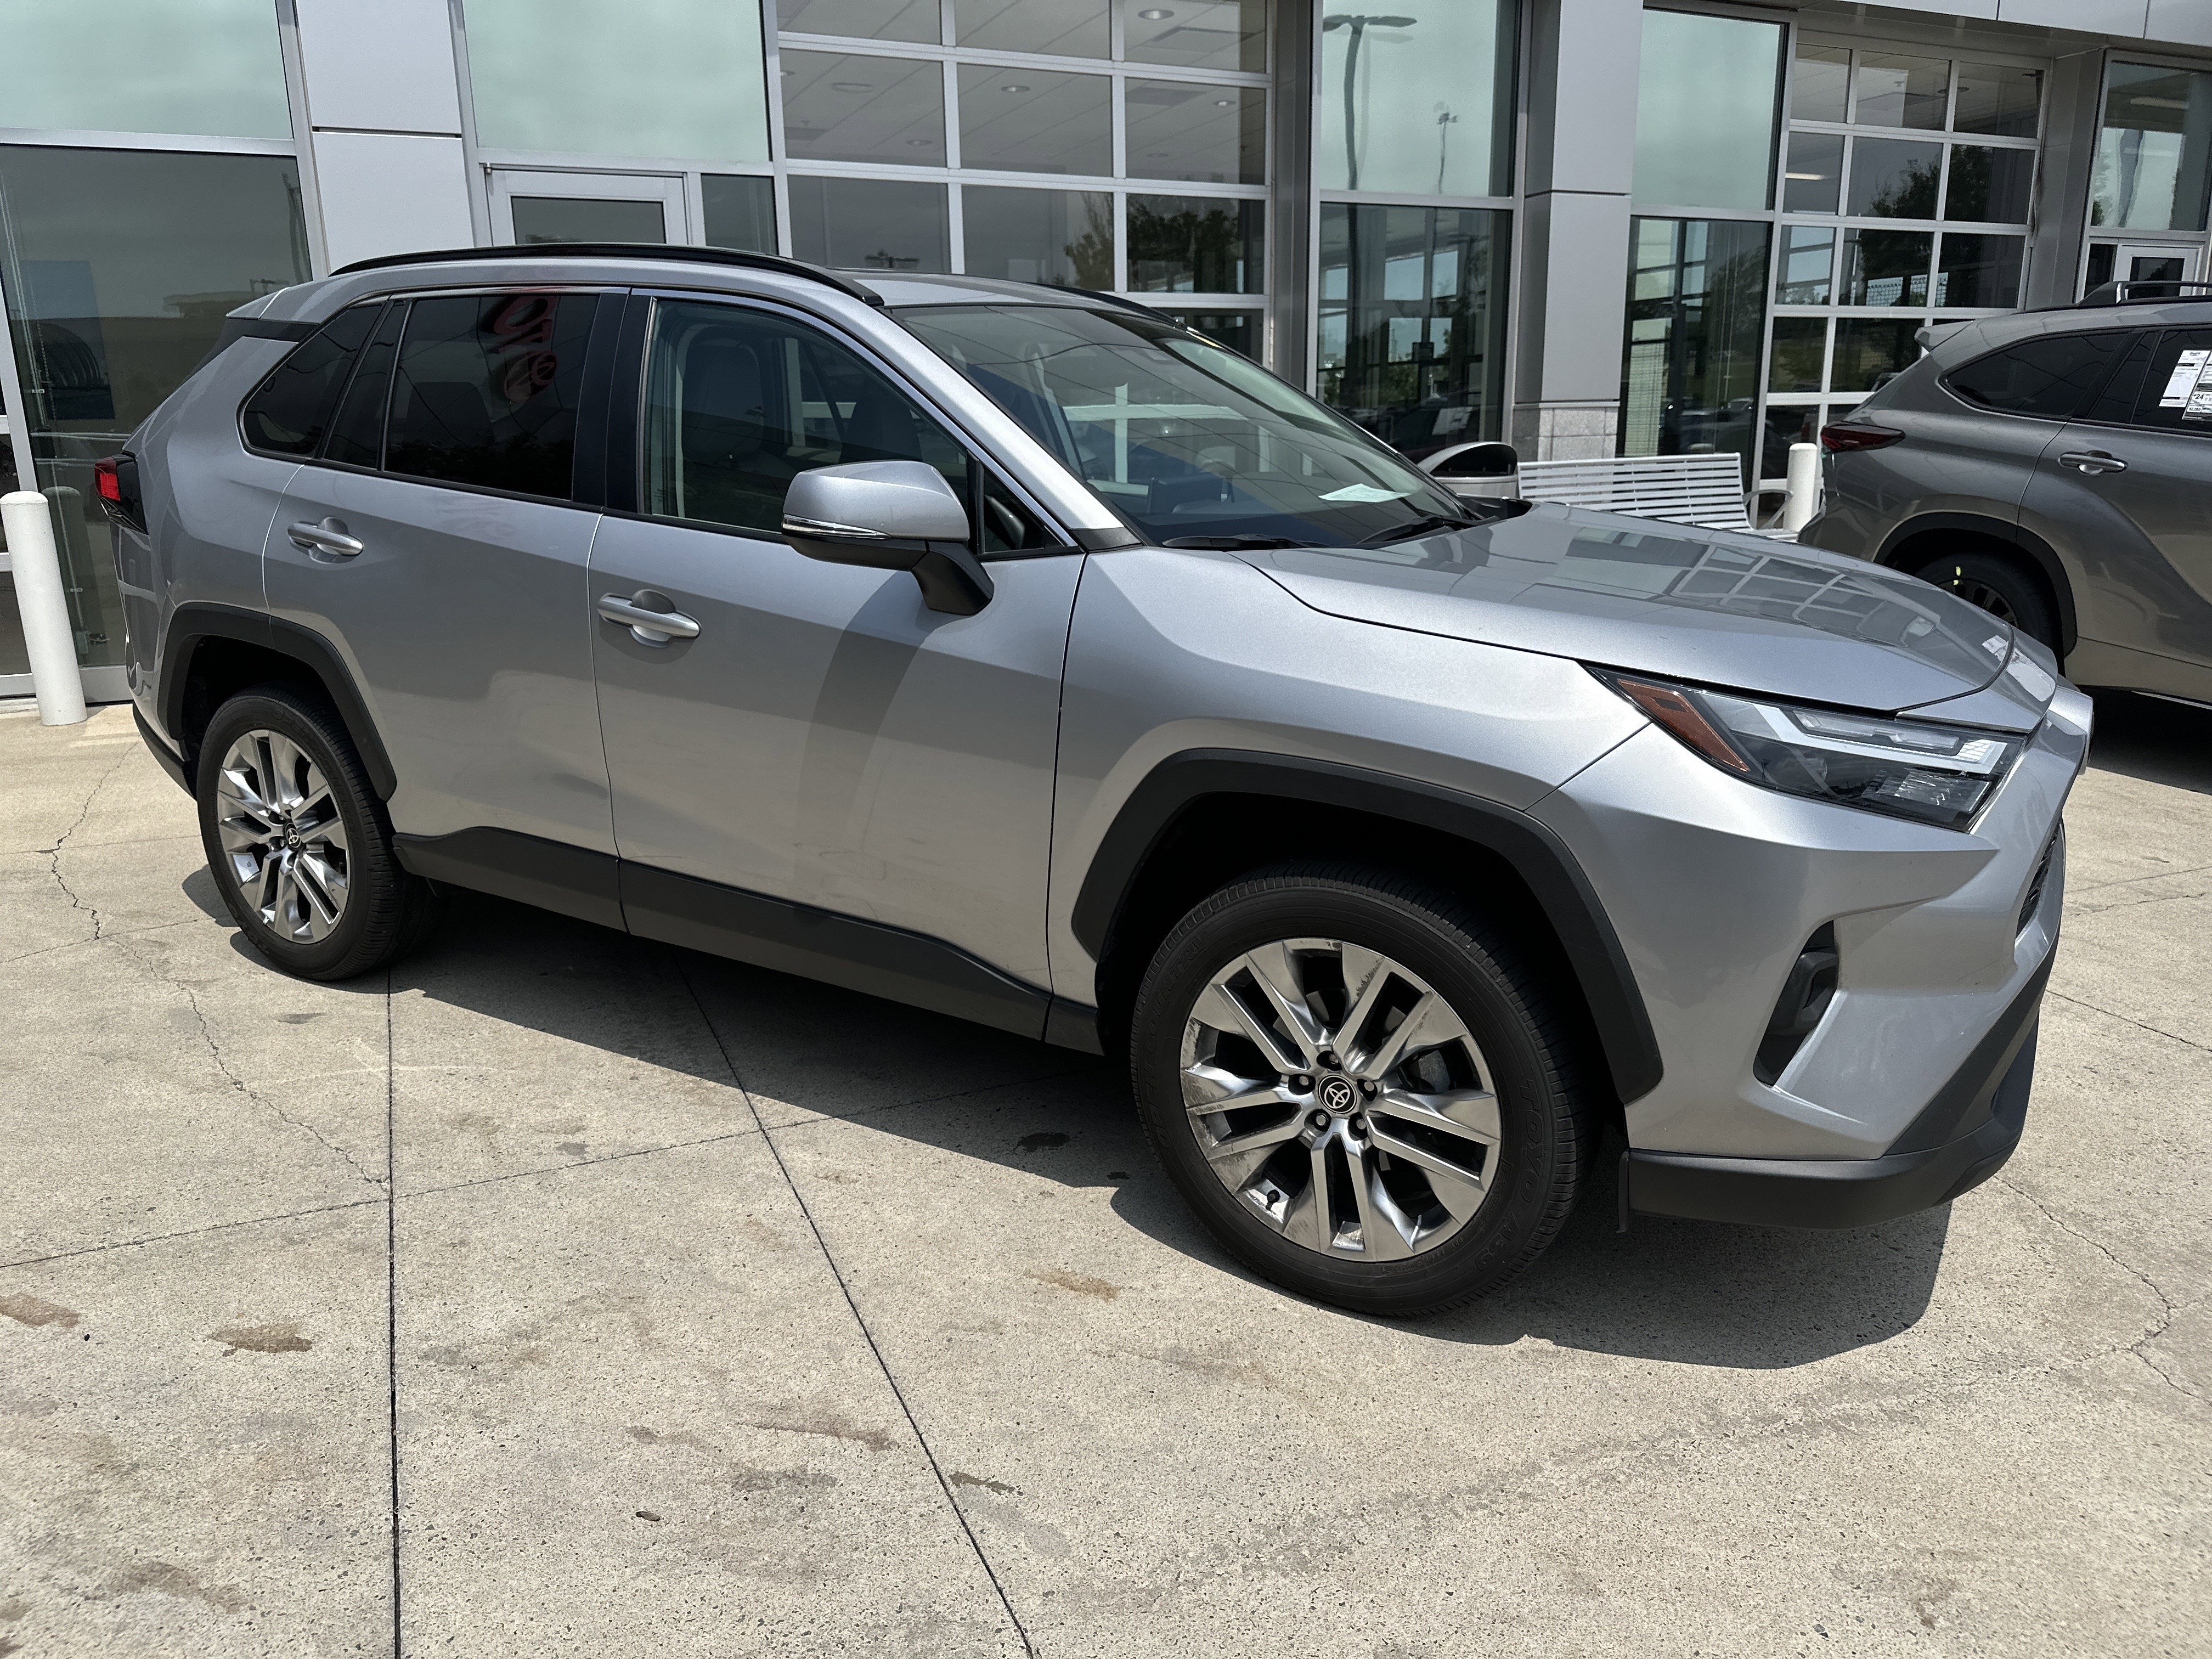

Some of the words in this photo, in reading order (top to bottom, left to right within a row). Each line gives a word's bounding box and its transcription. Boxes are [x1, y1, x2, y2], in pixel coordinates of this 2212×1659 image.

[1144, 934, 1208, 1054] COUNTRY
[1143, 1062, 1170, 1150] OPEN
[1520, 1079, 1544, 1203] TOYO
[1475, 1210, 1521, 1272] A39
